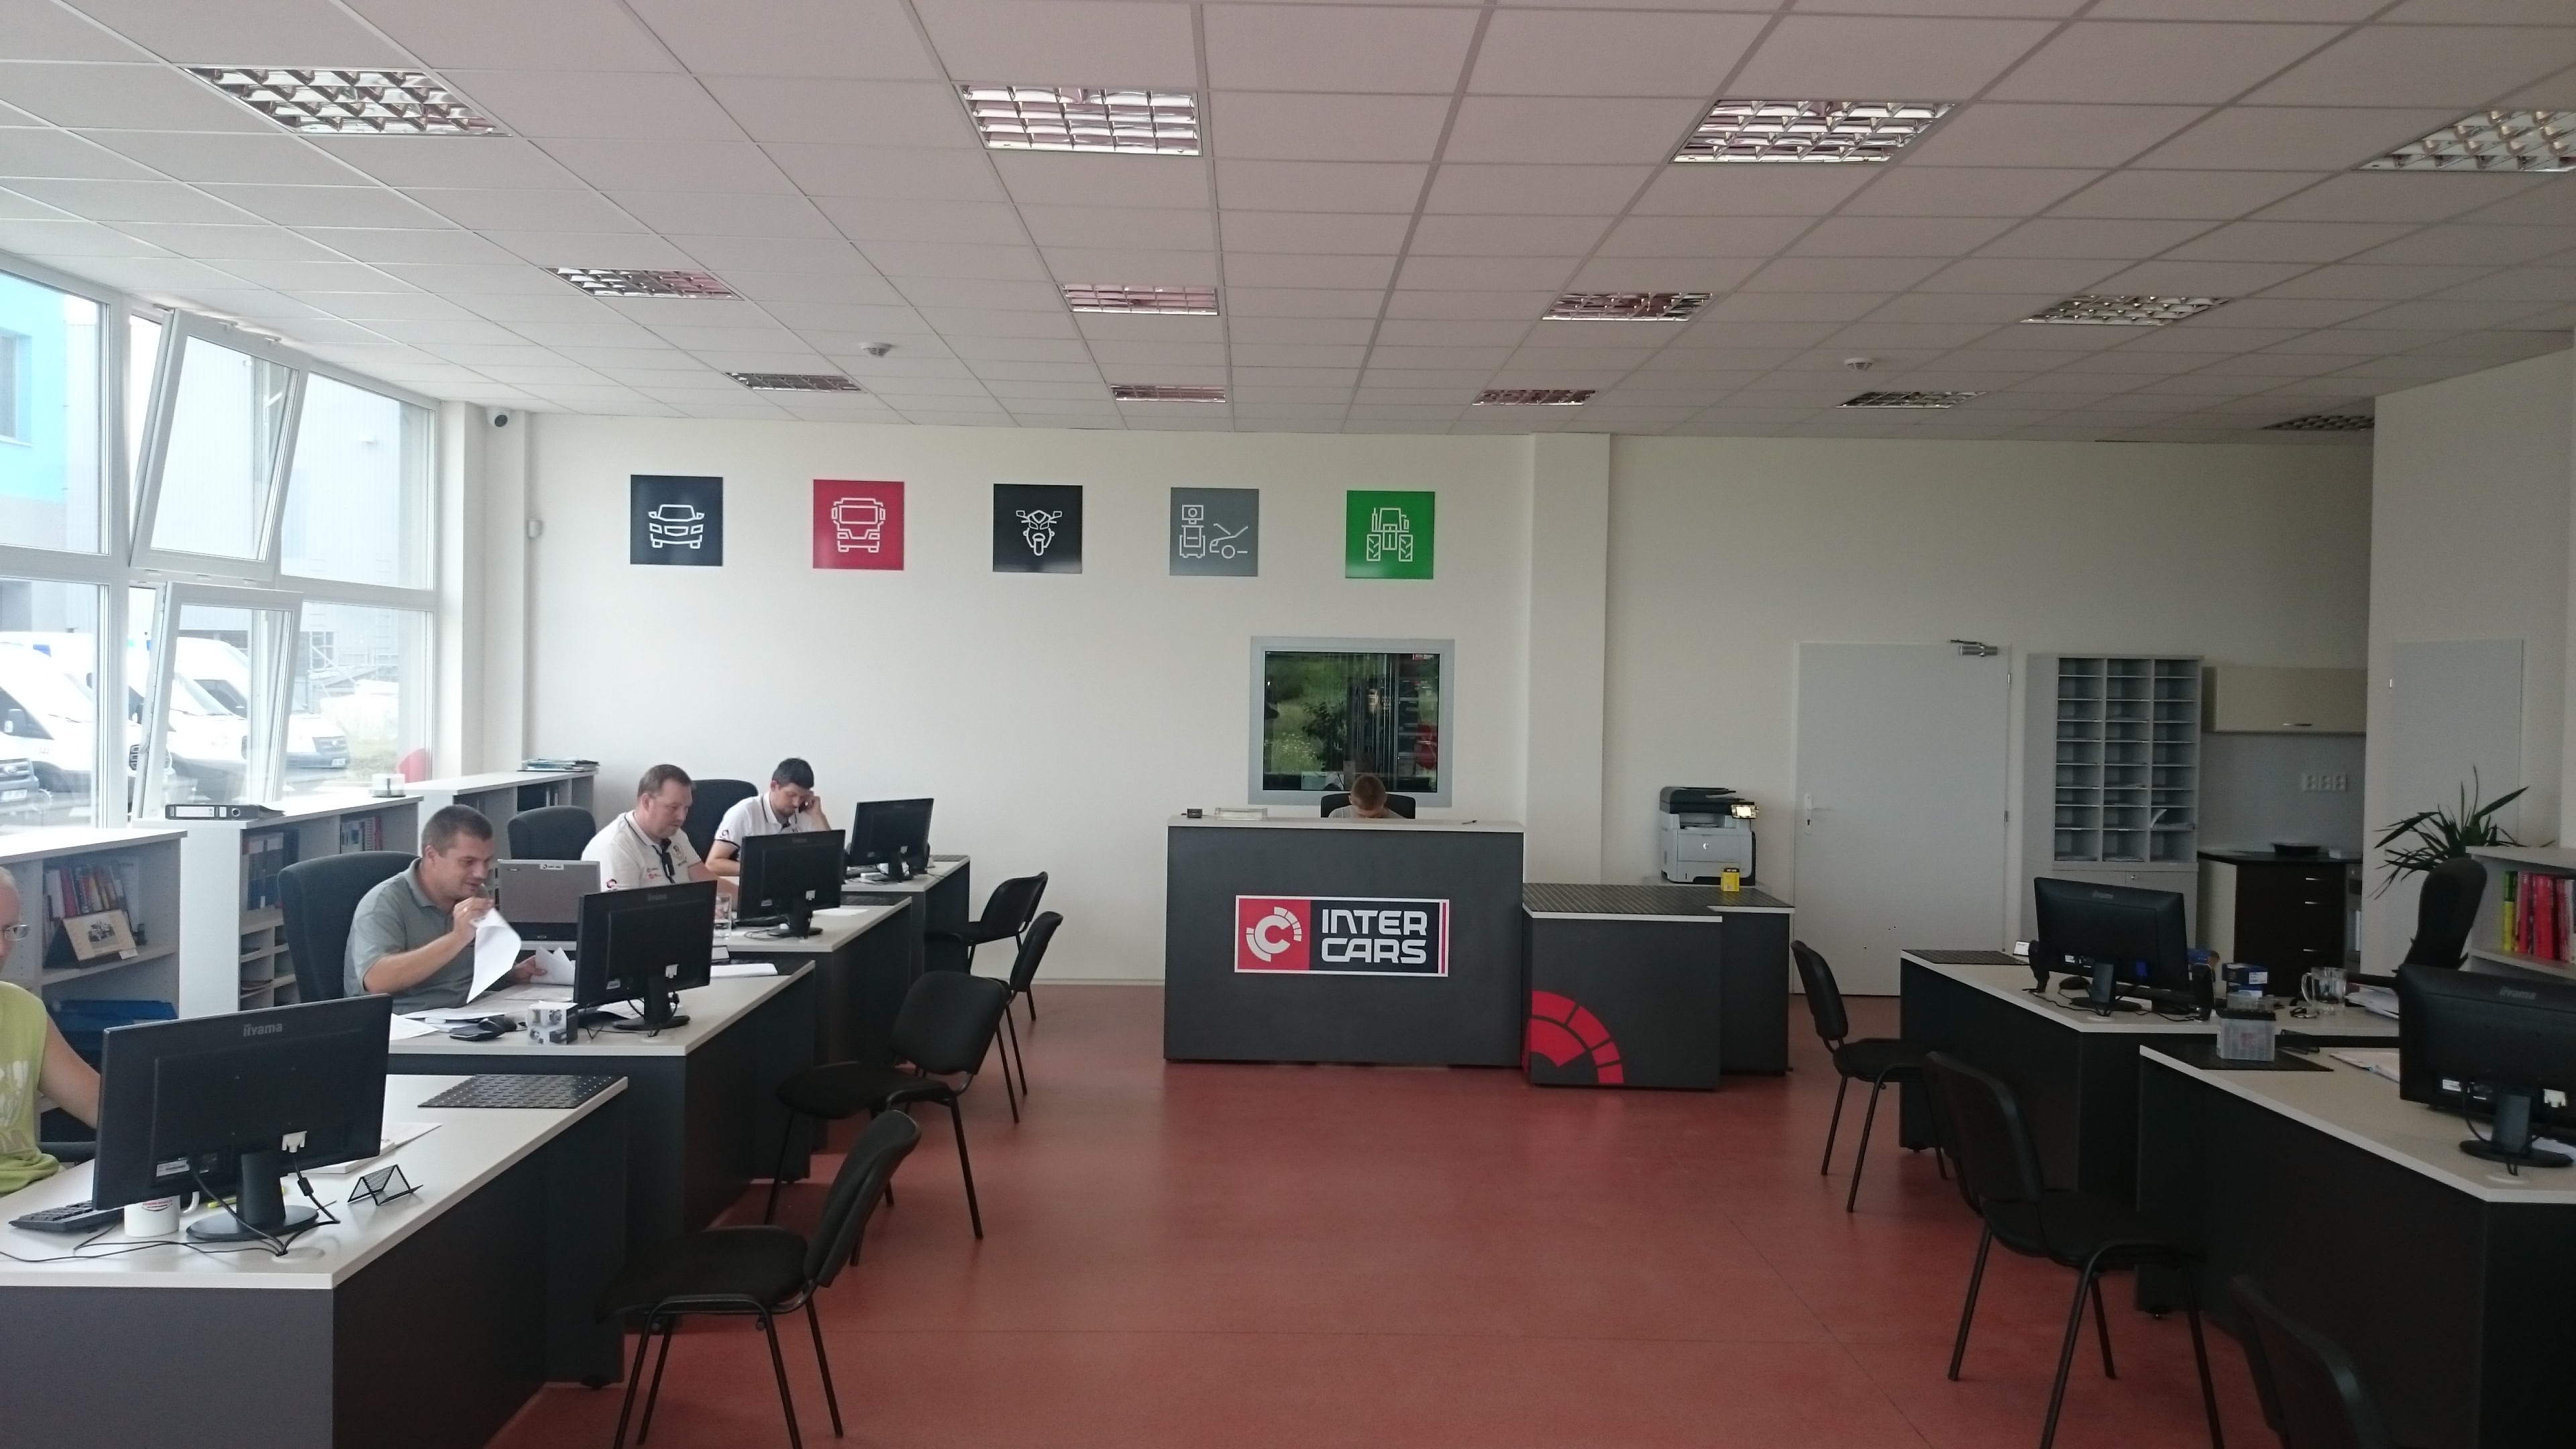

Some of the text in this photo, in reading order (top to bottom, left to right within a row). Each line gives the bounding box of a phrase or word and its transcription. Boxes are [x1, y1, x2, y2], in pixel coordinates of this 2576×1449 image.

[1322, 908, 1428, 936] INTER
[1321, 937, 1428, 964] CARS
[243, 1023, 283, 1037] iiyama
